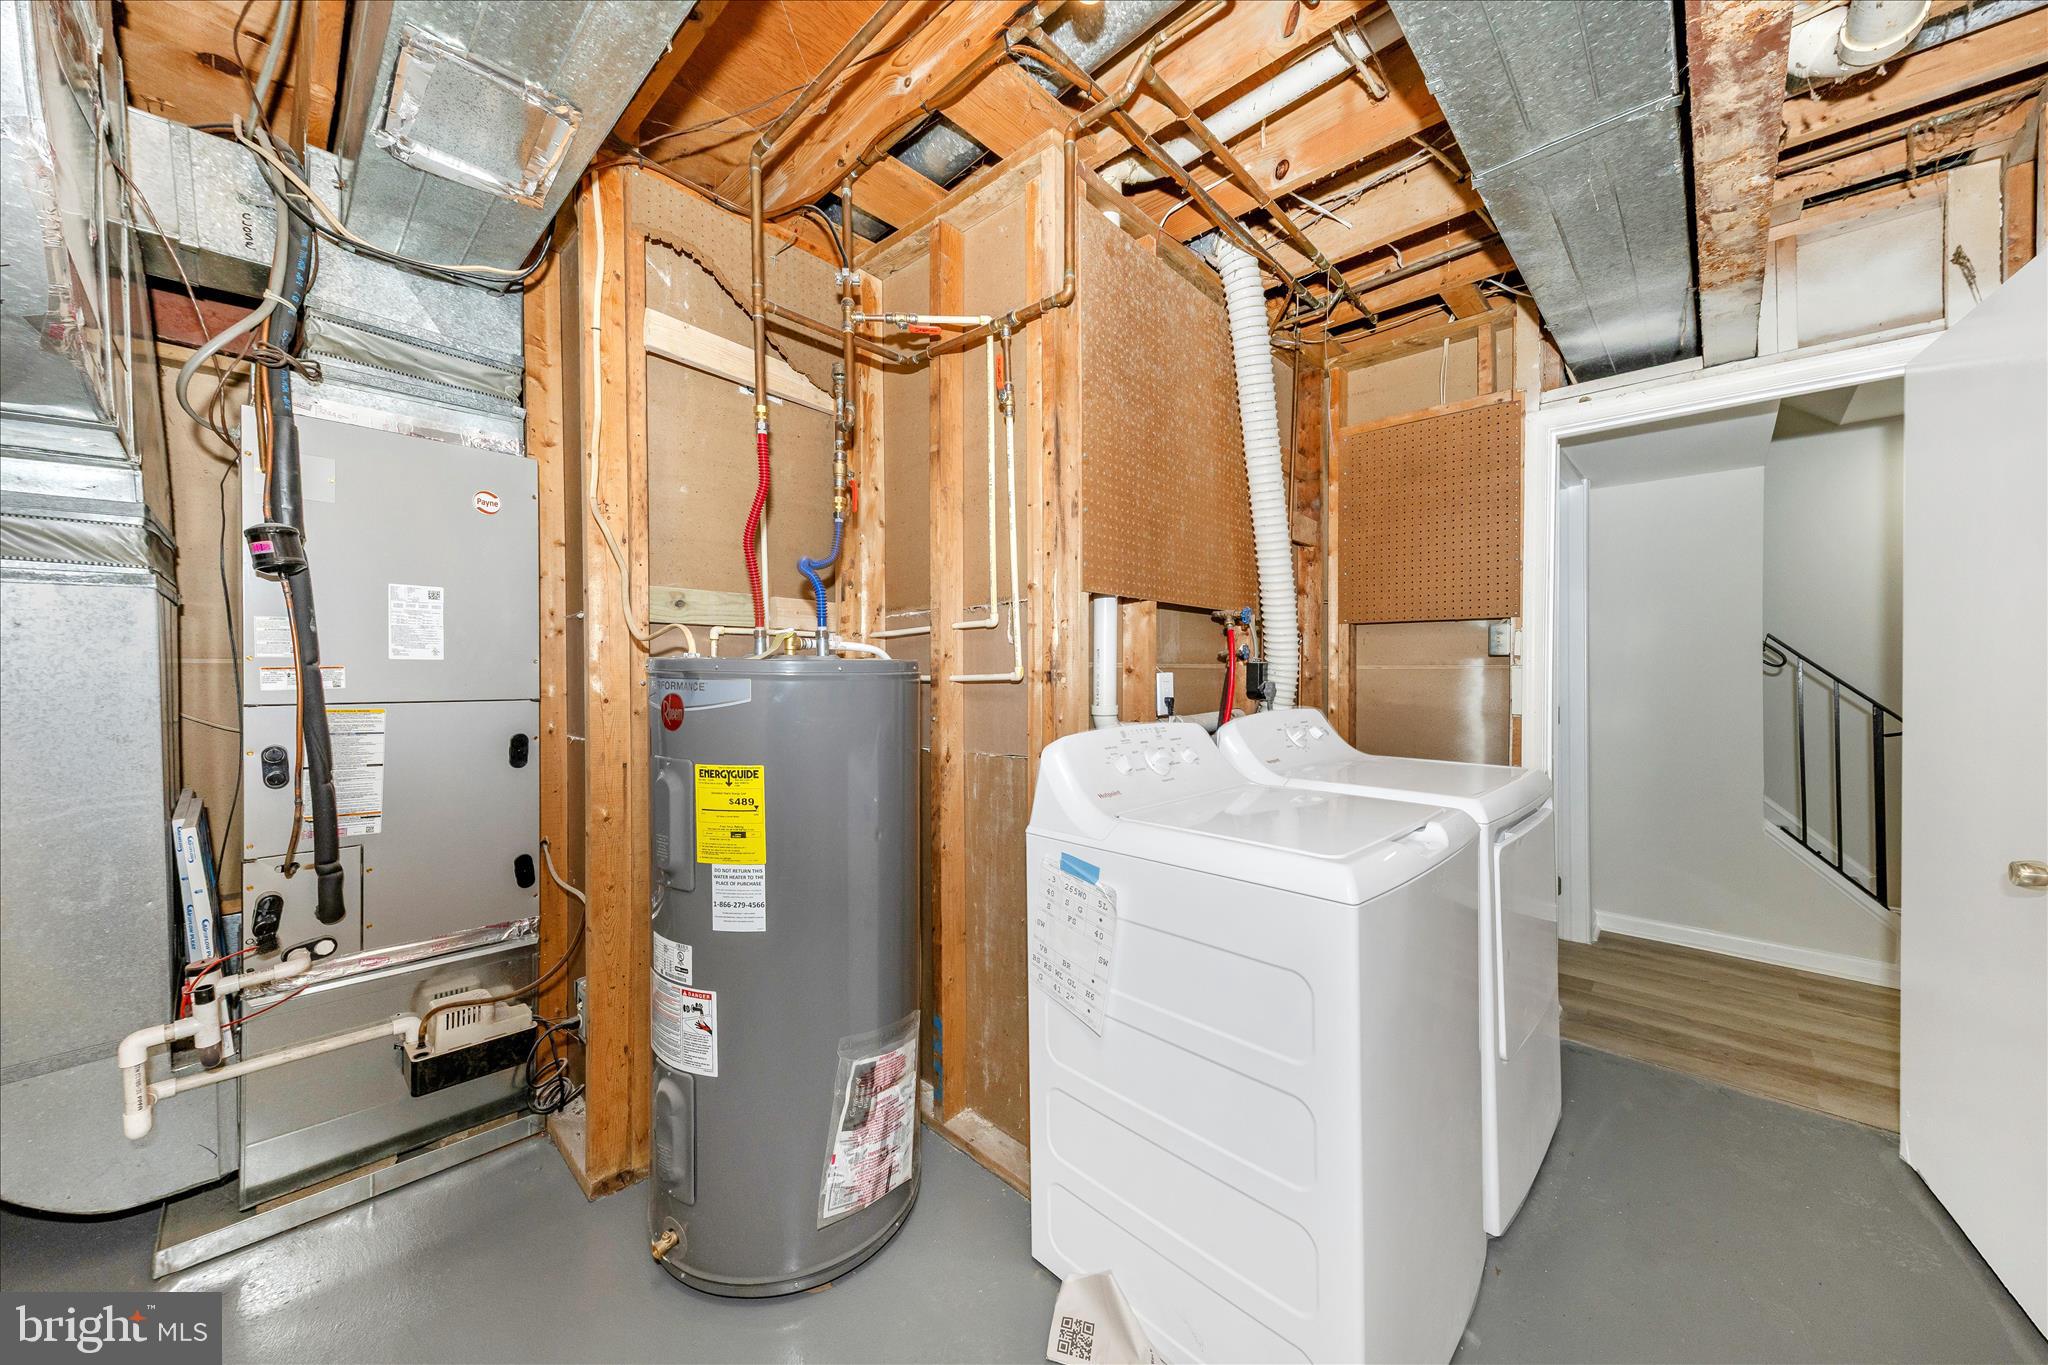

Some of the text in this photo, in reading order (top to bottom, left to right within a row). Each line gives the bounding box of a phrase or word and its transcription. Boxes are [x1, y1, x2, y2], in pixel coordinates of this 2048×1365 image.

[476, 497, 499, 508] Payne
[662, 696, 683, 726] Rheem
[699, 769, 759, 779] ENERGYGUIDE
[728, 797, 755, 806] $489
[1093, 929, 1105, 941] 40
[688, 991, 711, 1000] DANGER
